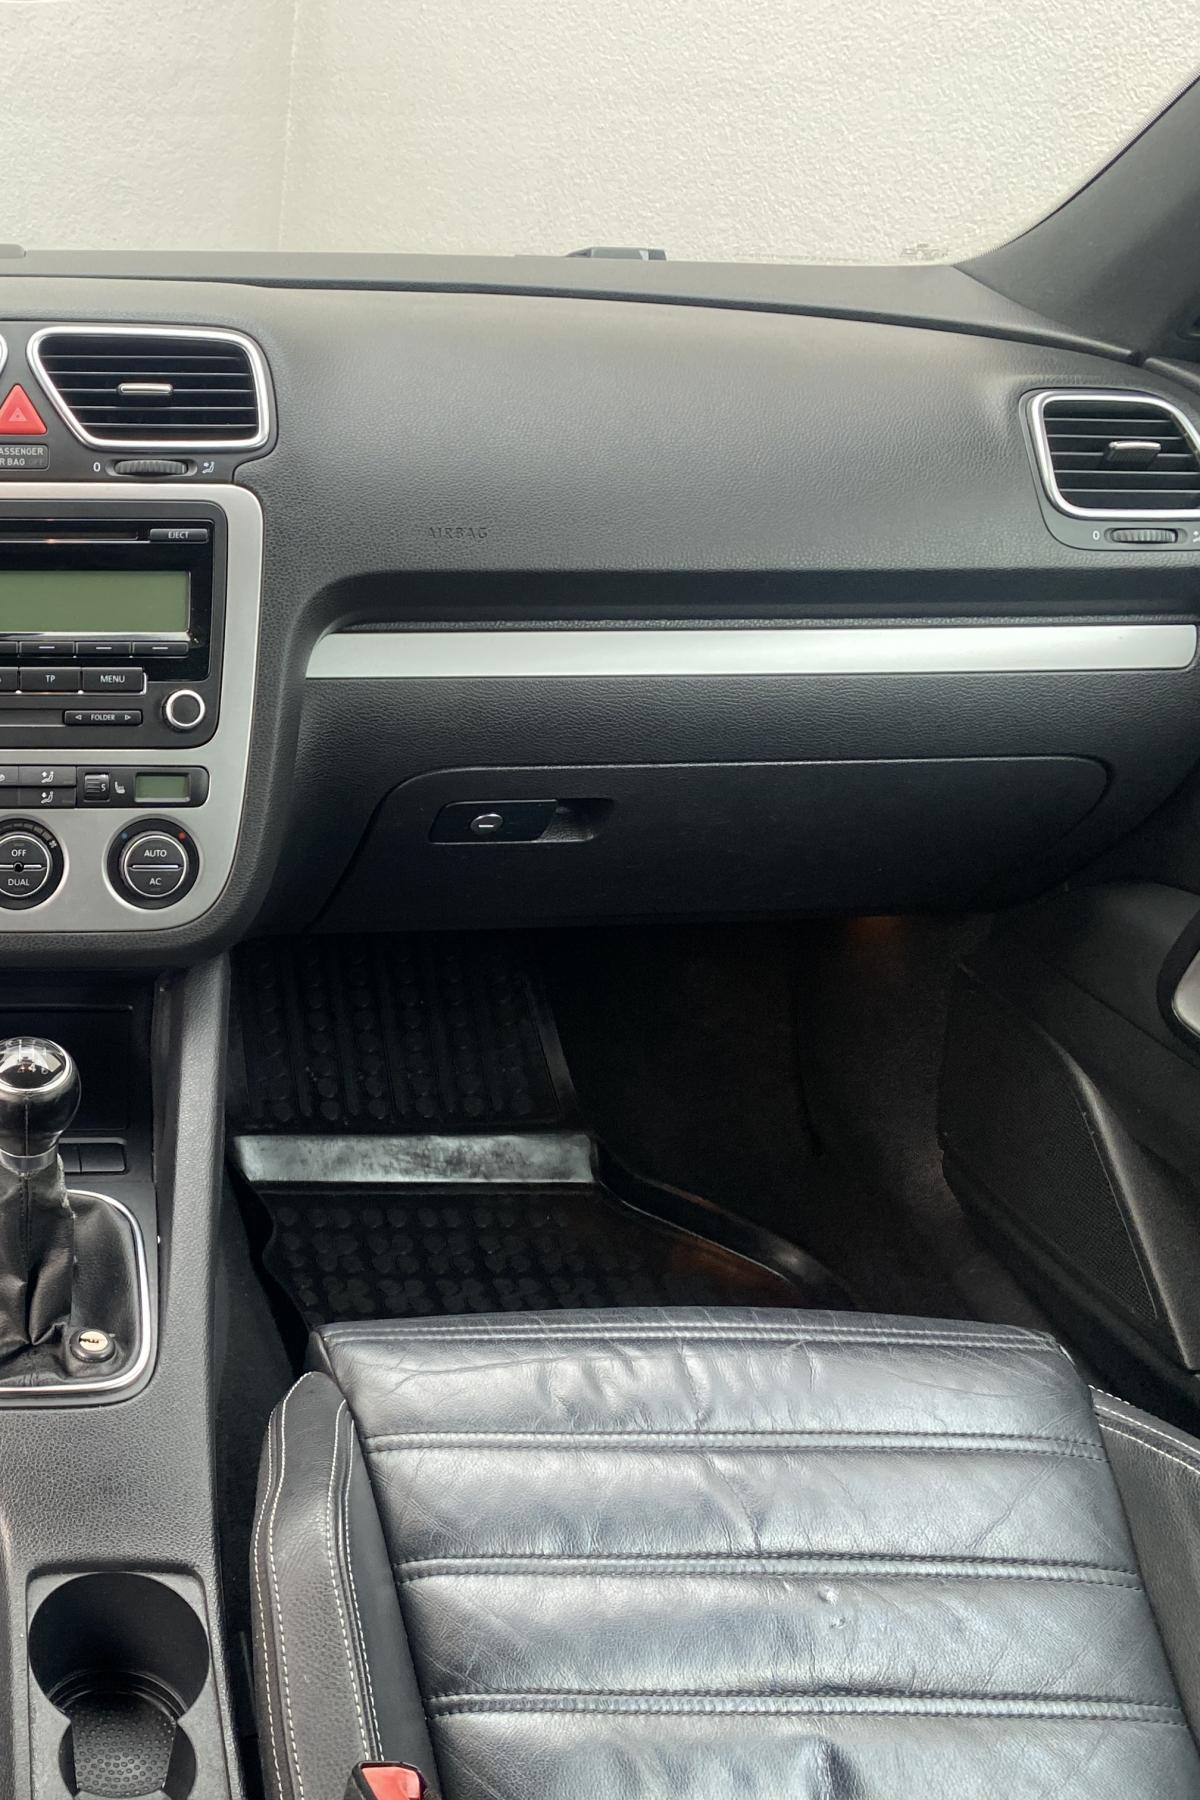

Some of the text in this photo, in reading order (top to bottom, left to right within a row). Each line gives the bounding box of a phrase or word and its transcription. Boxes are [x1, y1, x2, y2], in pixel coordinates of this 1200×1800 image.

[93, 461, 101, 472] 0
[168, 531, 189, 539] EJECT
[428, 526, 488, 539] AIRBAG
[1092, 530, 1100, 540] 0
[45, 674, 56, 683] TP
[100, 675, 126, 683] MENU
[11, 849, 27, 857] OFF
[144, 849, 167, 857] AUTO
[7, 878, 30, 886] DUAL
[149, 878, 162, 886] AC
